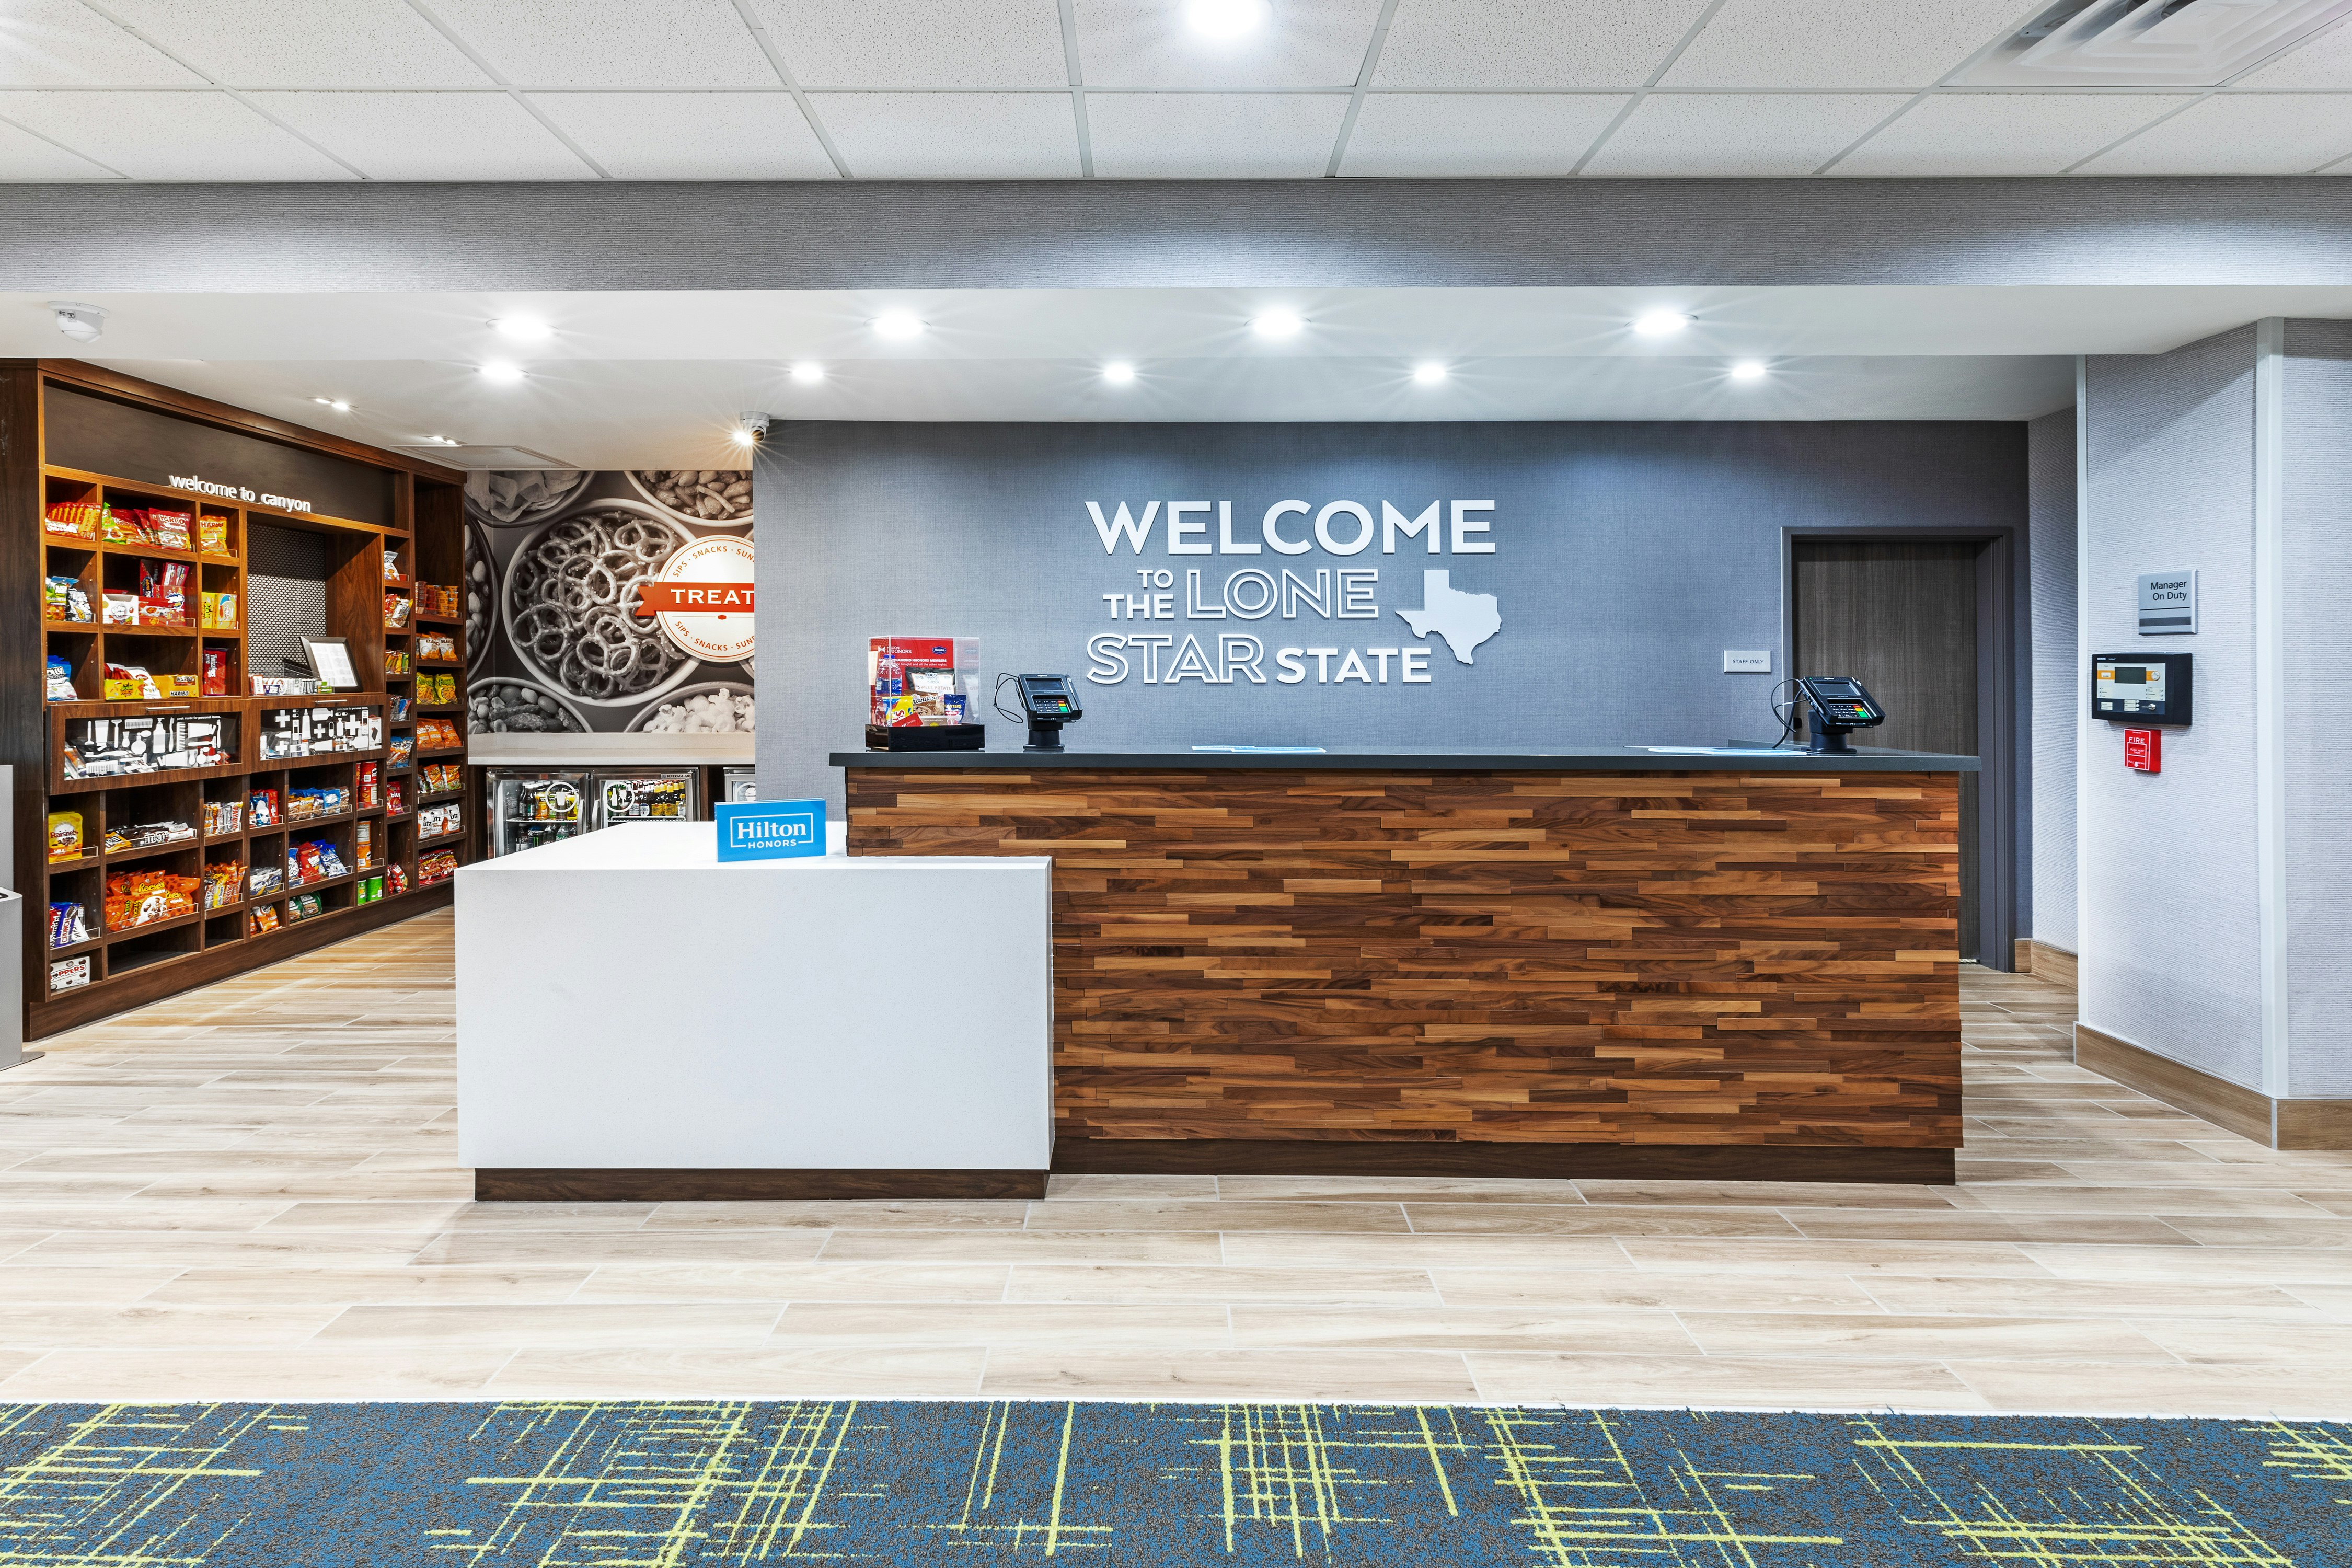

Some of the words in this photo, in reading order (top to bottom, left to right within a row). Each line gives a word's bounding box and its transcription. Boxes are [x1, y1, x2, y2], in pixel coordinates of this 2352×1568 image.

[168, 475, 237, 499] welcome
[239, 487, 256, 502] to
[261, 493, 311, 513] canyon
[1085, 499, 1496, 556] WELCOME
[673, 560, 688, 578] SIPS
[693, 546, 728, 559] SNACKS
[736, 548, 755, 563] SUN
[1137, 569, 1174, 589] TO
[2150, 581, 2187, 590] Manager
[670, 588, 755, 605] TREAT
[1103, 593, 1175, 620] THE
[1186, 568, 1379, 620] LONE
[2167, 592, 2187, 601] Duty
[675, 621, 690, 637] SIPS
[694, 638, 728, 651] SNACKS
[1086, 633, 1267, 685] STAR
[1276, 647, 1432, 684] STATE
[737, 821, 806, 839] Hilton
[748, 839, 797, 849] HONORS
[138, 881, 165, 892] Reese's
